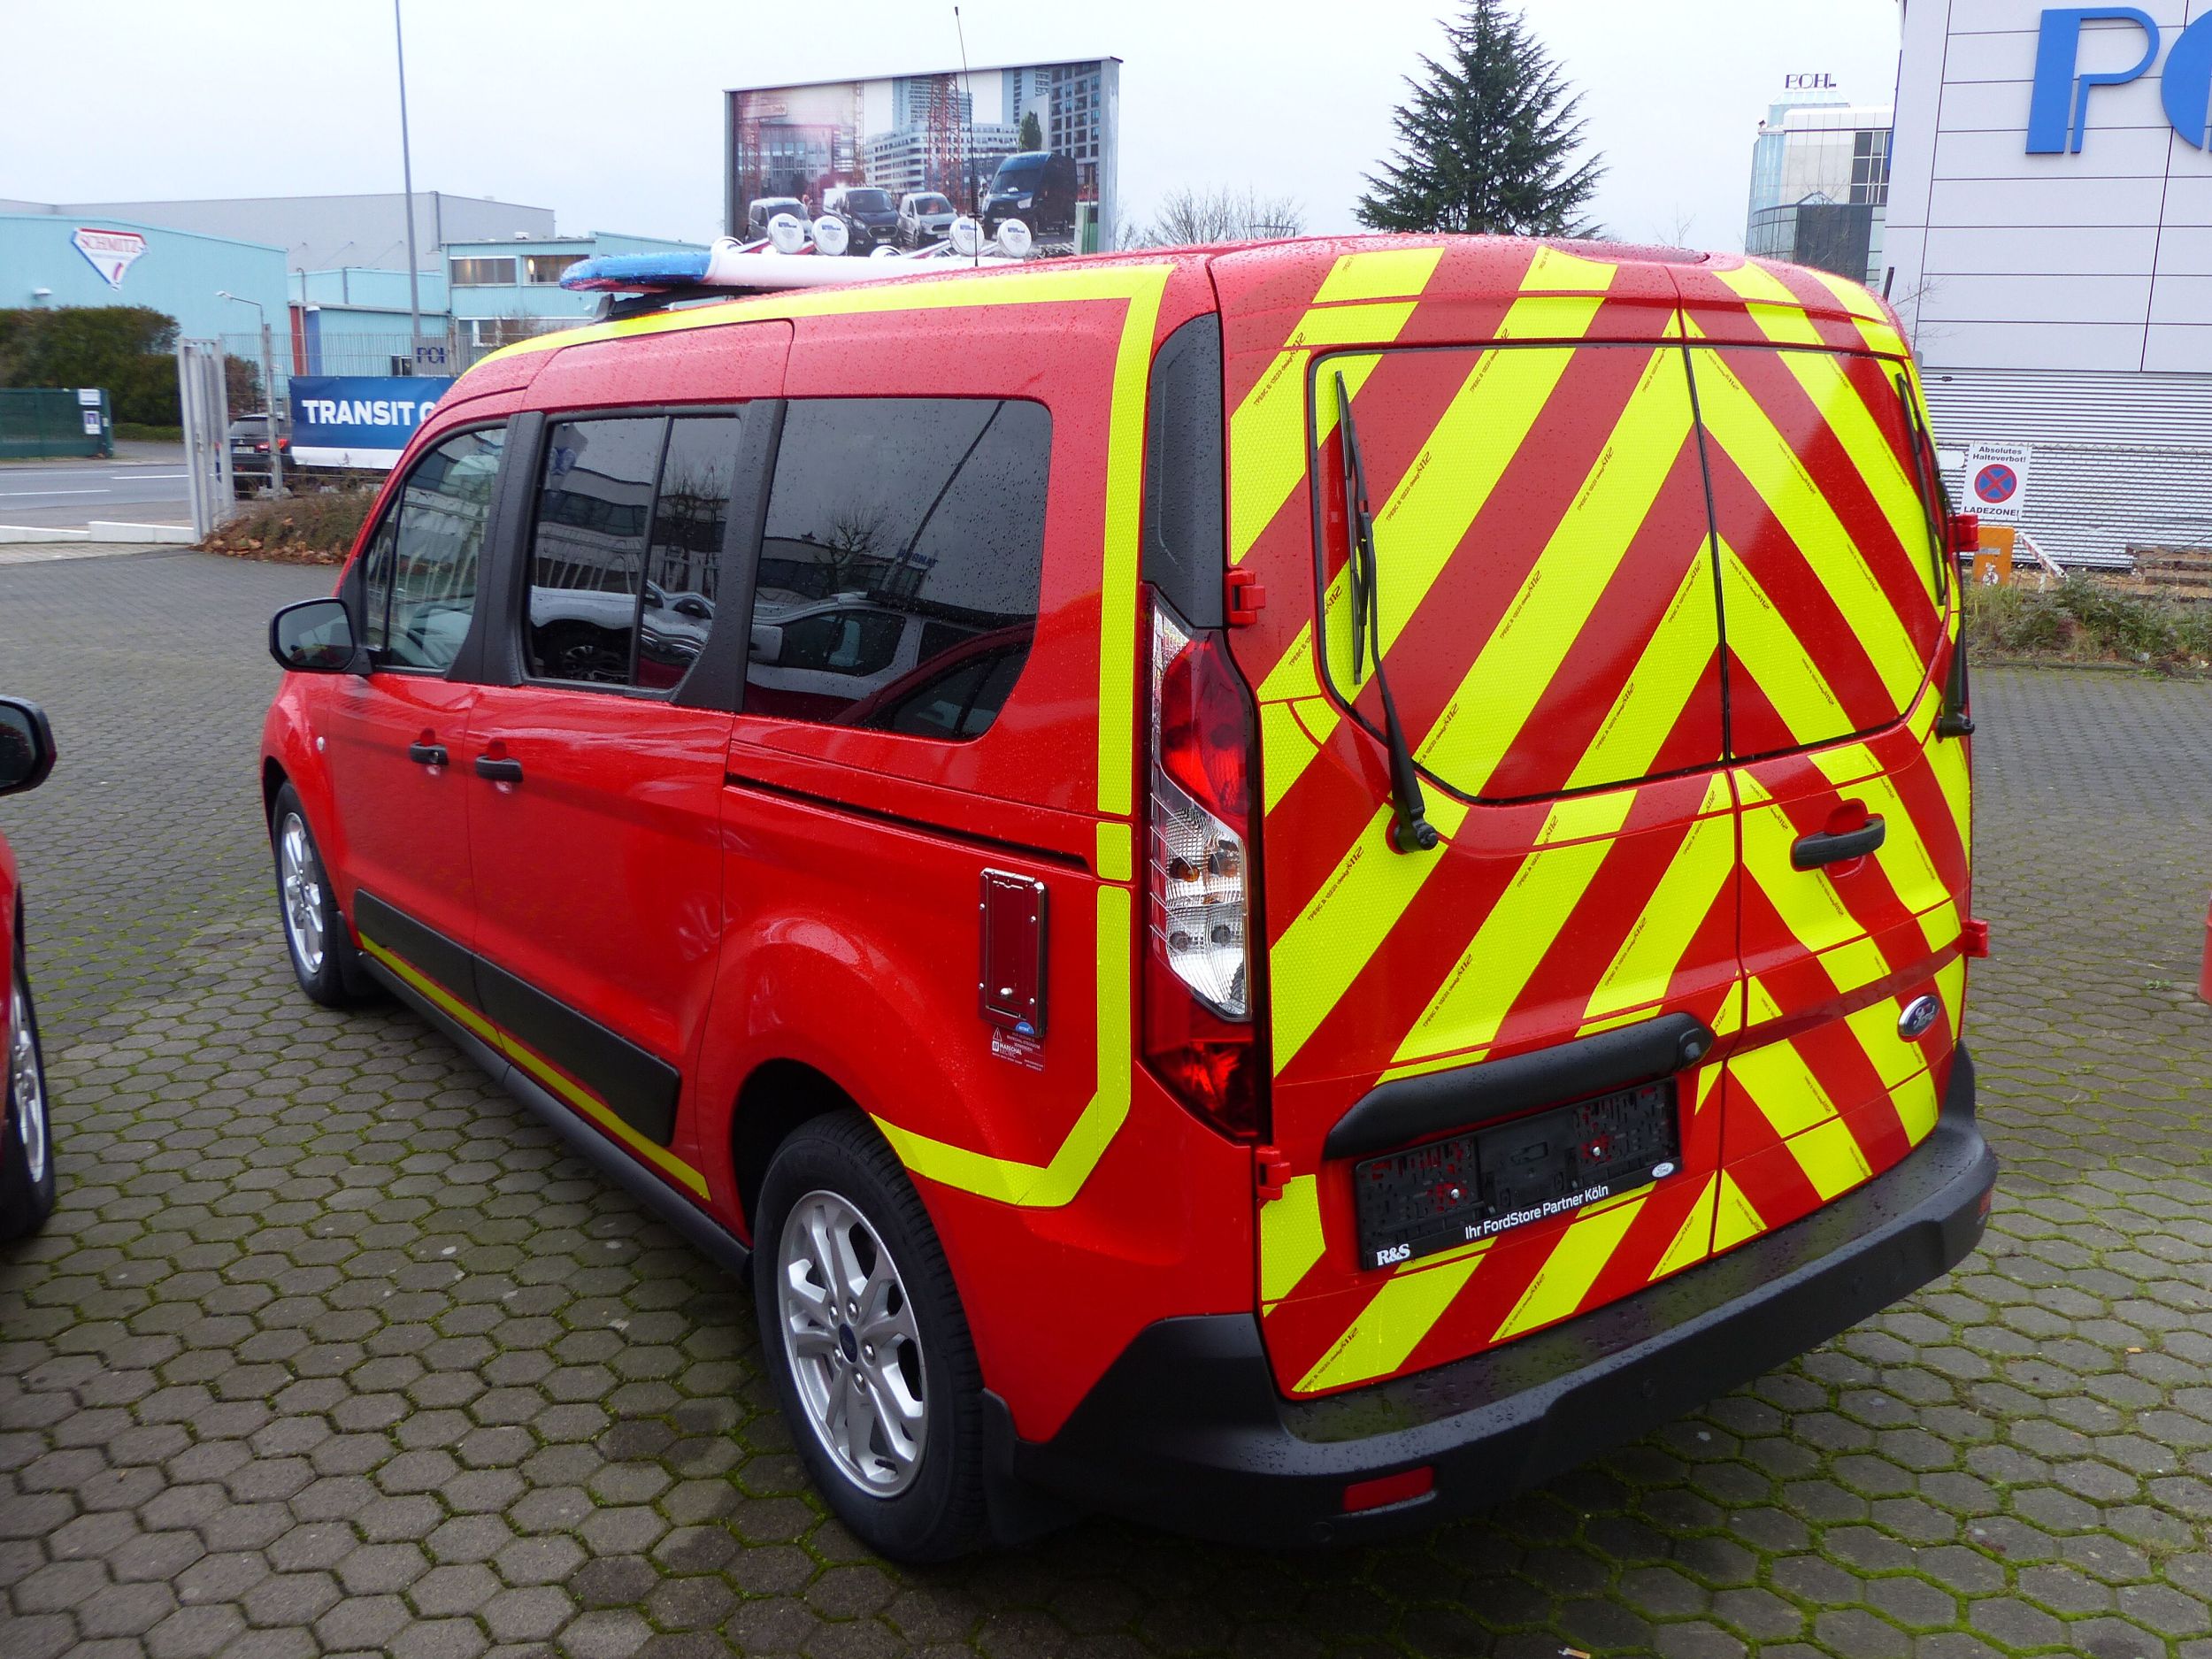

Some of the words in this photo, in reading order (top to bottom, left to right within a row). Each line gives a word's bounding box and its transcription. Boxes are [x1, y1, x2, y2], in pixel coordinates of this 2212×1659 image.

[1786, 73, 1836, 88] POHL
[80, 234, 140, 253] SCHMITZ
[301, 400, 415, 426] TRANSIT
[1972, 454, 2026, 463] Halteverbot!
[1978, 446, 2023, 455] Absolutes
[1963, 506, 2019, 517] LADEZONE!
[1464, 1223, 1482, 1240] Ihr
[1484, 1207, 1541, 1233] FordStore
[1542, 1194, 1584, 1217] Partner
[1584, 1184, 1609, 1202] Köln
[1376, 1244, 1410, 1266] R&S
